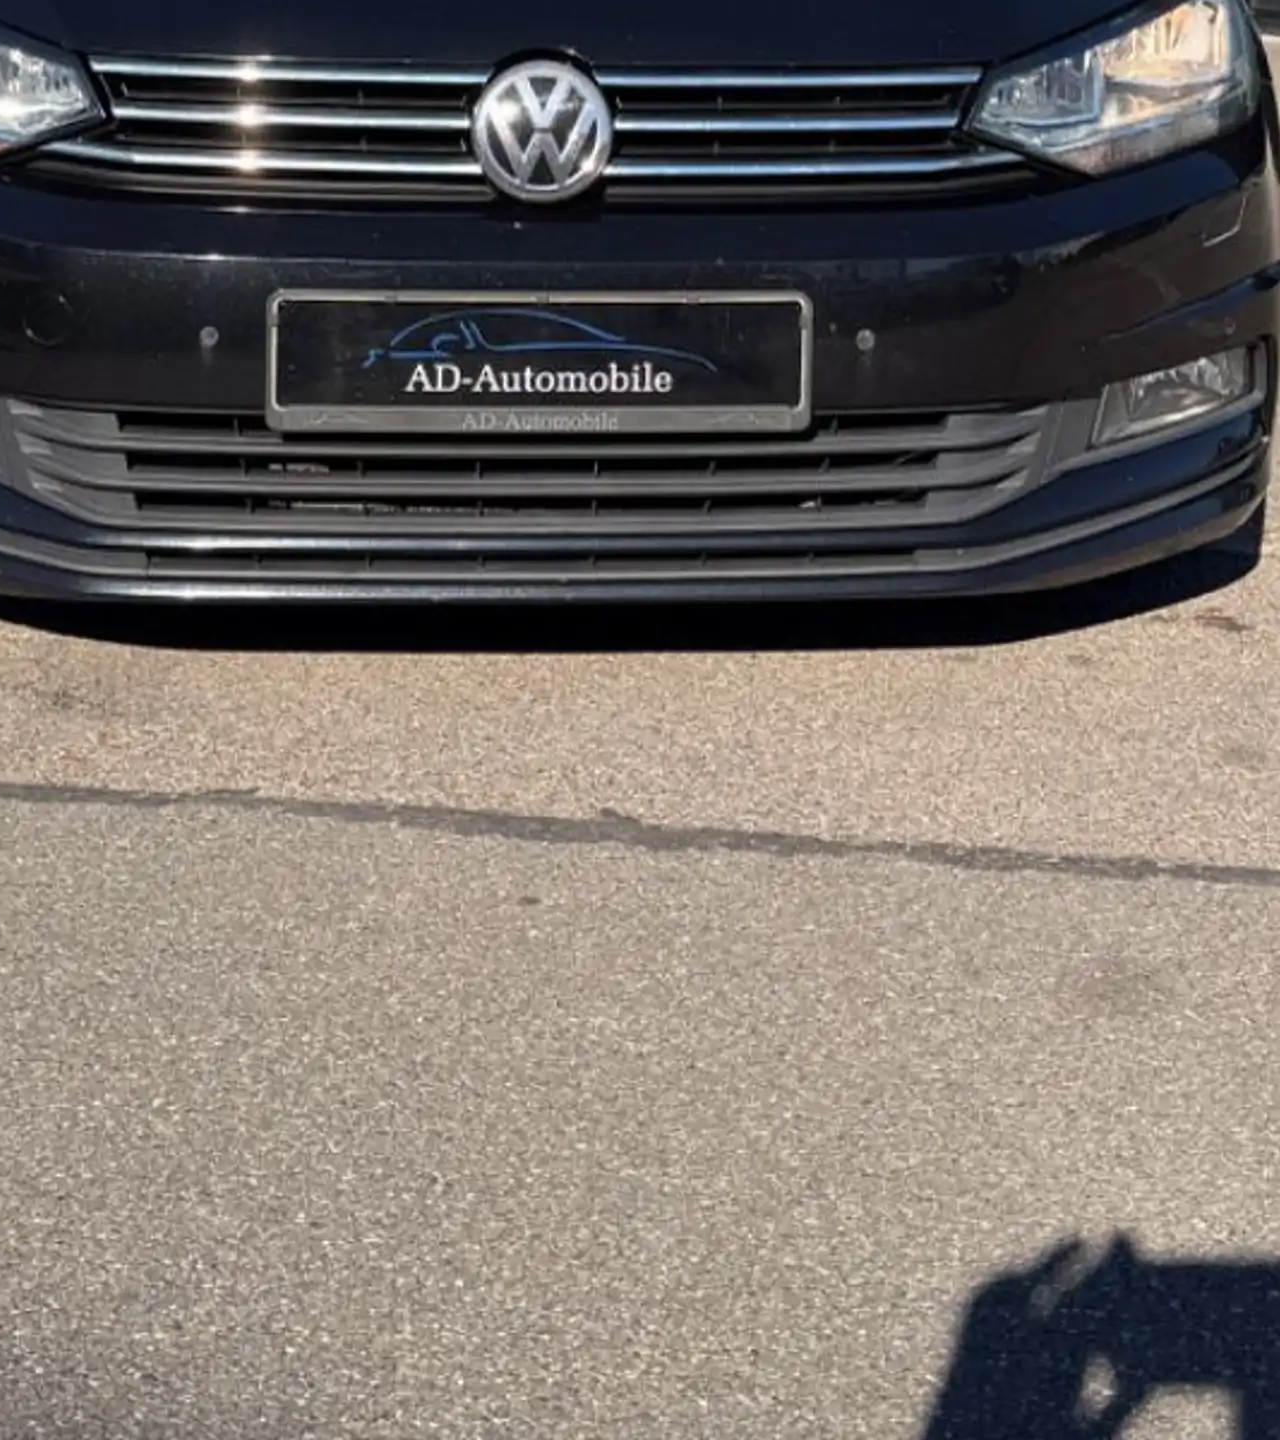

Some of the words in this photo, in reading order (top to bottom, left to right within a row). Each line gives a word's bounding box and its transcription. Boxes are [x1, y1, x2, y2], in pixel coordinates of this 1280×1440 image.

[478, 65, 607, 196] VW
[405, 362, 673, 393] AD-Automobile
[461, 412, 619, 432] AD-Automobile
